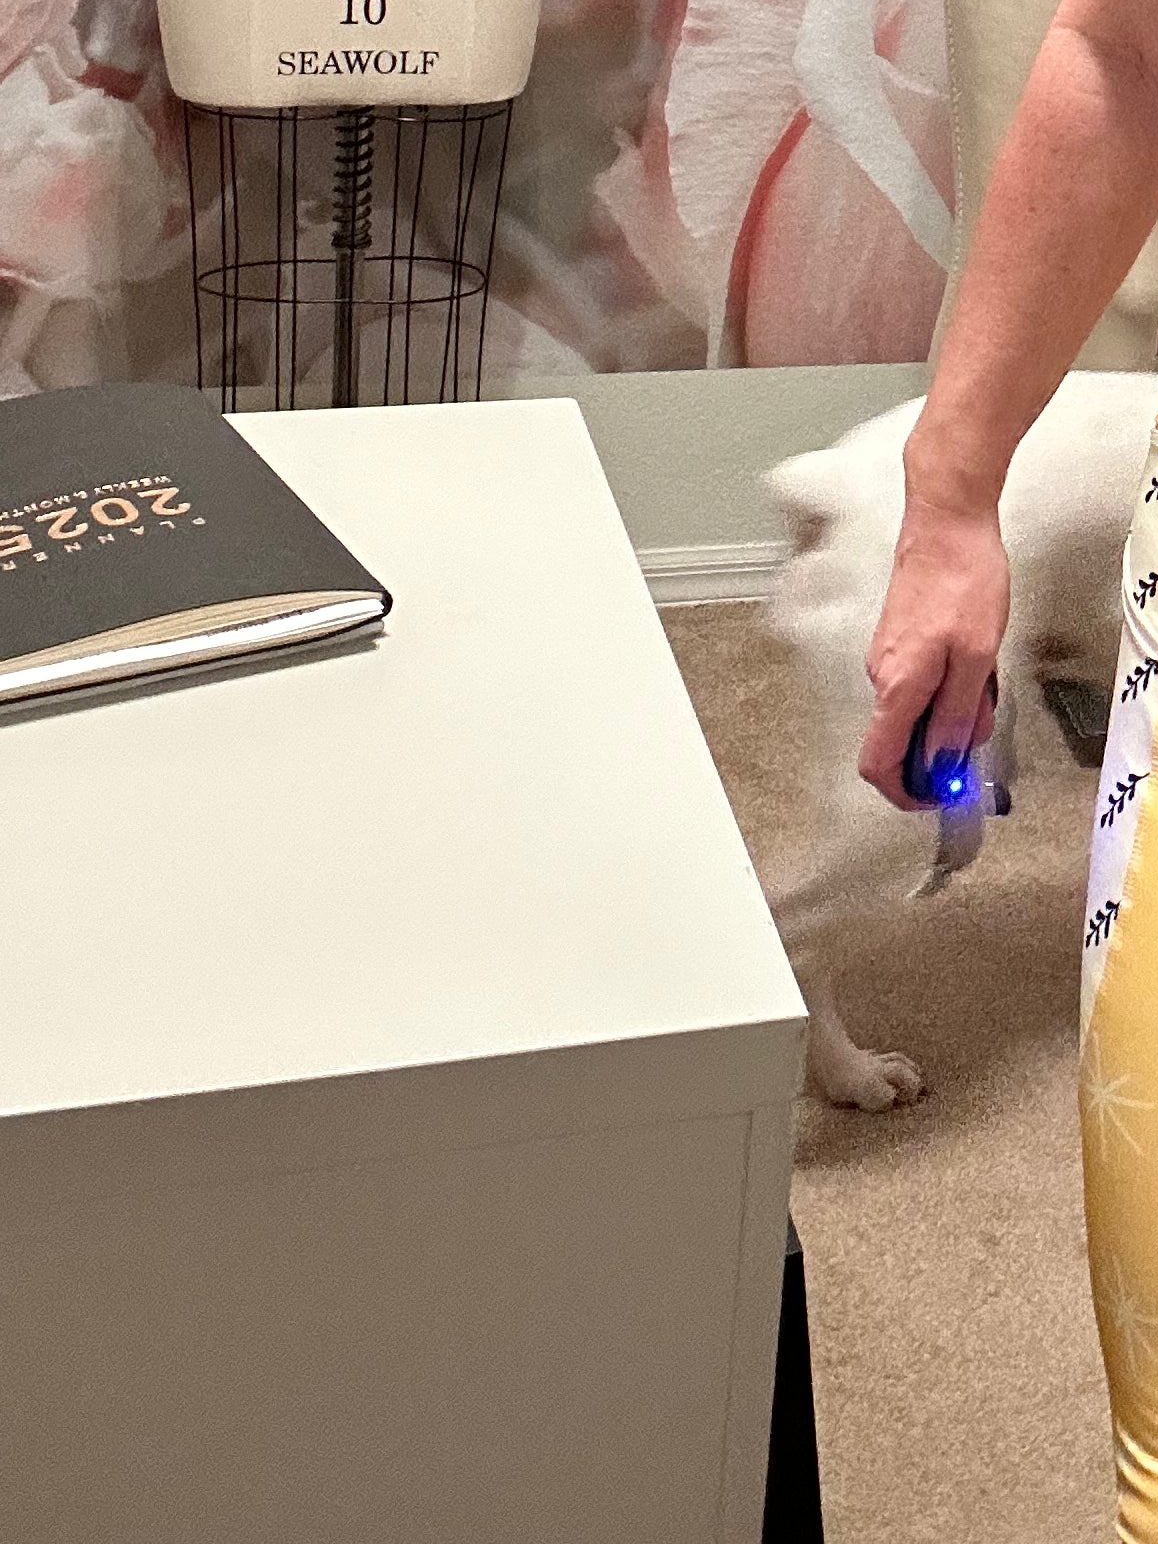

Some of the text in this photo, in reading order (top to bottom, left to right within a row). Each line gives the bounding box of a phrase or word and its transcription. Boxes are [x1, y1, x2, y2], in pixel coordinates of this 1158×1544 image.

[277, 50, 439, 76] SEAWOLF
[93, 475, 172, 496] WEEKLY
[0, 486, 191, 557] 2025
